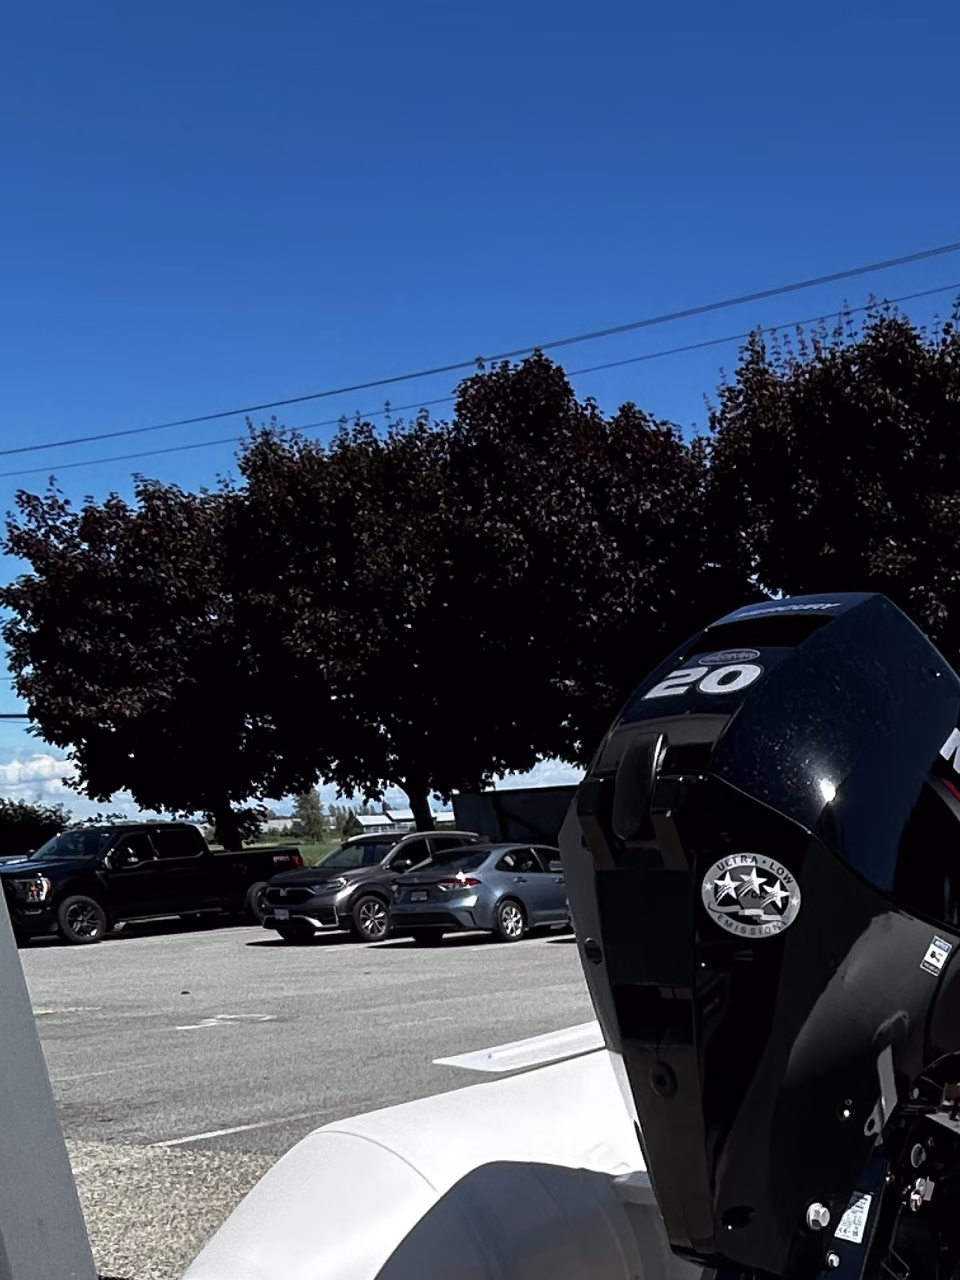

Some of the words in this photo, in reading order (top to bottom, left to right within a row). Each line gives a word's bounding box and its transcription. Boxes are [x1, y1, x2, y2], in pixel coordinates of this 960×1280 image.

[642, 664, 761, 699] 20
[716, 854, 759, 872] ULTRA
[769, 861, 794, 885] LOW
